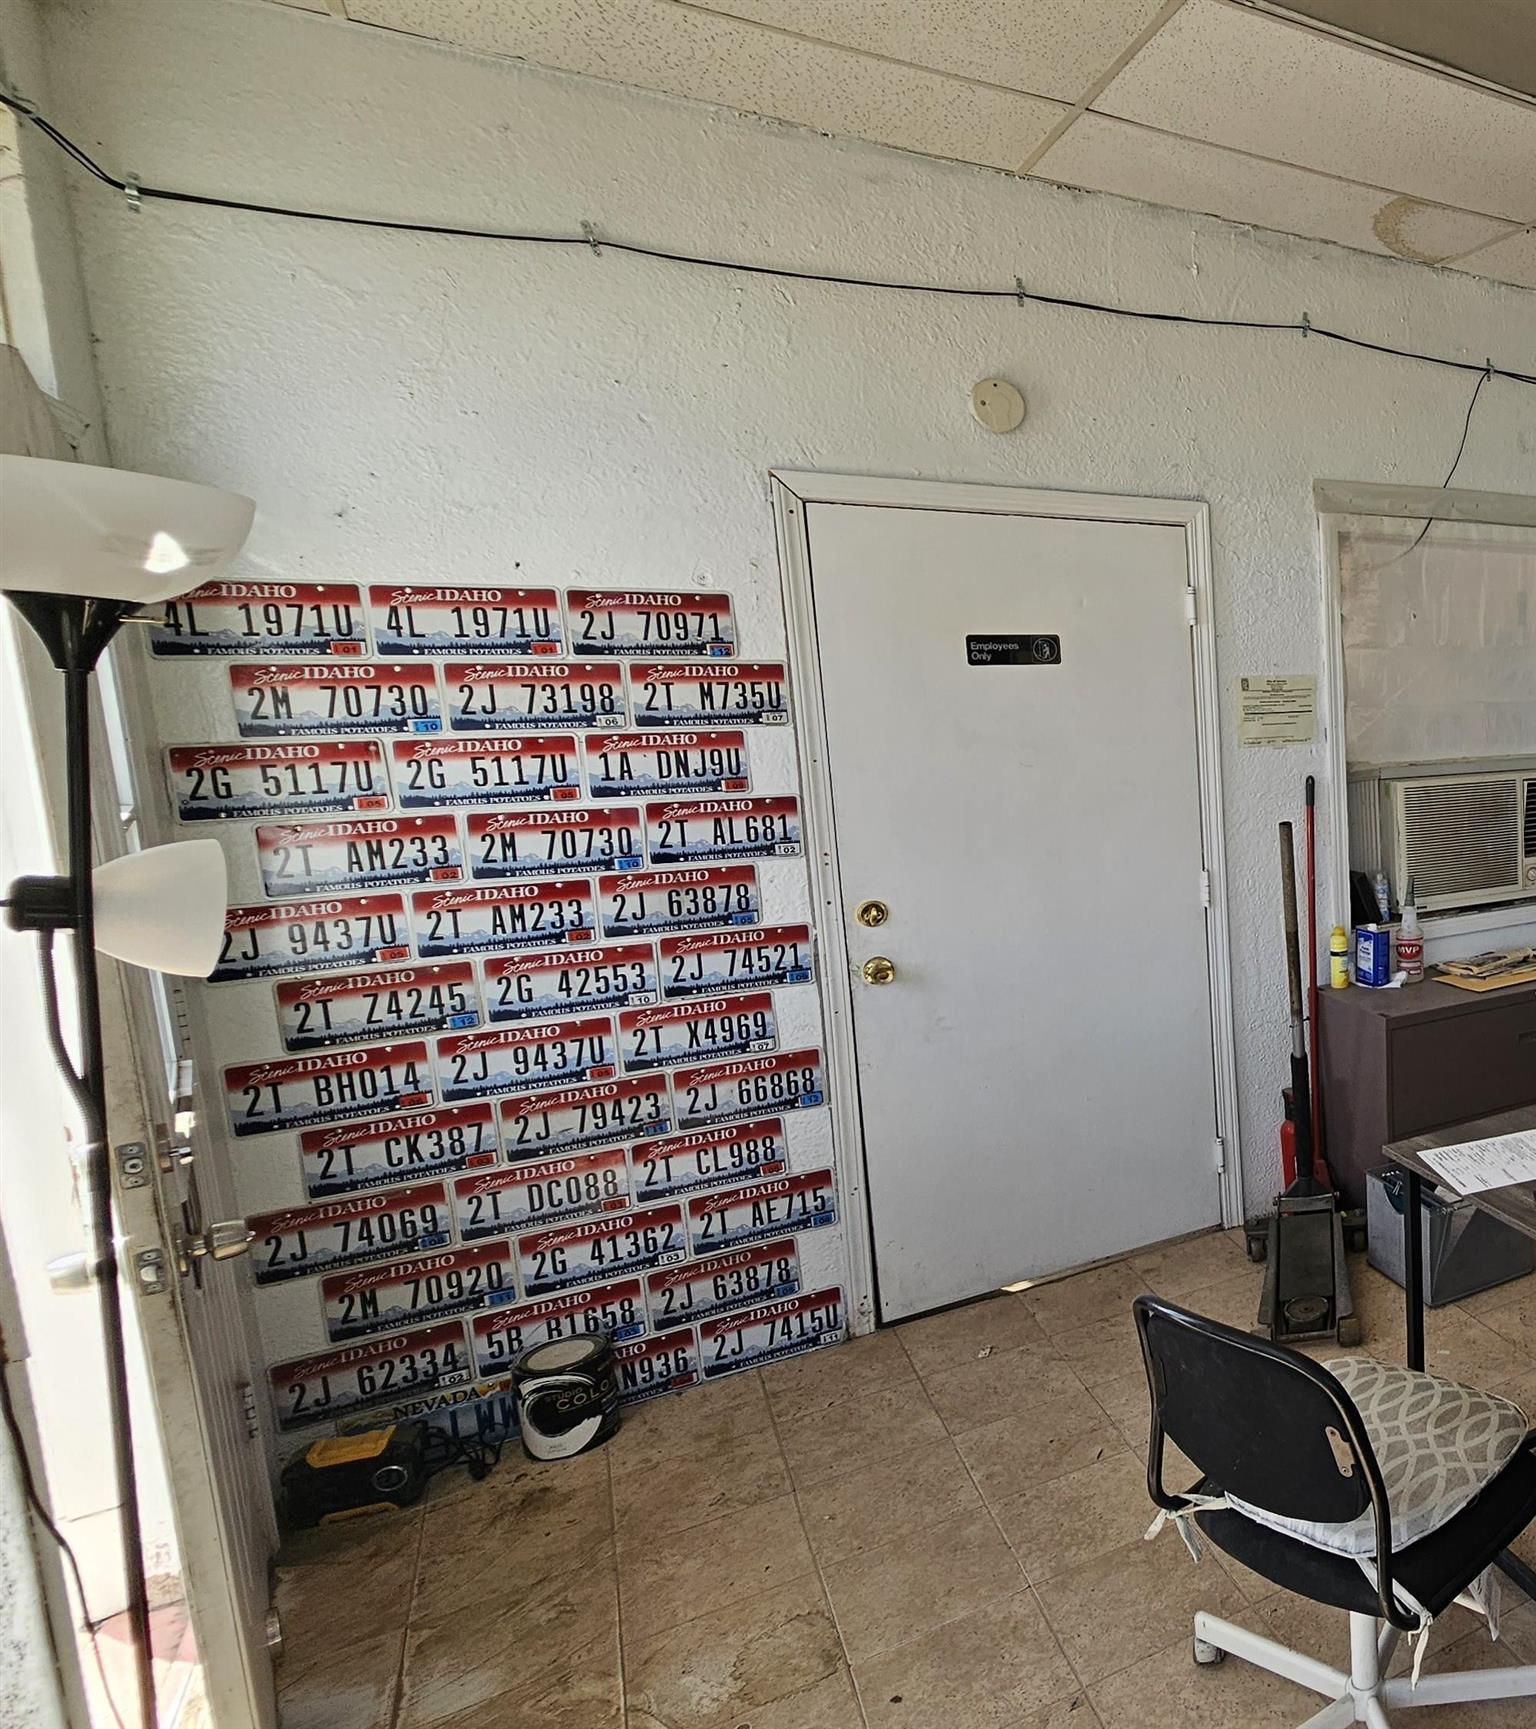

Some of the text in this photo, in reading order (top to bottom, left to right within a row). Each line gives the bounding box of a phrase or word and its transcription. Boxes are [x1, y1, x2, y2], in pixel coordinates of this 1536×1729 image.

[391, 588, 502, 605] Scenic IDAHO
[585, 593, 682, 609] Scenic IDAHO
[164, 603, 353, 639] 4L 1971U
[385, 606, 551, 641] 4L 1971U
[580, 610, 723, 642] 2J 70971
[970, 642, 1019, 651] Employees
[971, 651, 992, 661] Only
[254, 665, 375, 685] Scenic IDAHO
[463, 665, 569, 682] Scenic IDAHO
[646, 665, 739, 681] Scenic IDAHO
[247, 684, 429, 721] 2M 70730
[458, 682, 615, 715] 2J 73198
[643, 682, 782, 712] 2T M735U
[494, 722, 536, 730] FAMOUS
[602, 732, 697, 751] Scenic IDAHO
[194, 744, 320, 767] Scenic IDAHO
[412, 738, 522, 759] Scenic IDAHO
[598, 748, 741, 783] 1A DNJ9U
[185, 761, 374, 804] 2G 5117U
[405, 755, 568, 793] 2G 5117U
[629, 786, 713, 796] FAMOUS POTATOES
[444, 795, 540, 806] FAMOUS POTATOES
[662, 798, 753, 820] Scenic IDAHO
[326, 819, 398, 837] IDAHO
[485, 811, 589, 831] Scenic IDAHO
[657, 813, 791, 850] 2T AL681
[272, 834, 450, 880] 2T AM233
[480, 826, 632, 864] 2M 70730
[514, 865, 605, 877] FAMOUS POTATOES
[616, 869, 709, 892] Scenic IDAHO
[432, 884, 539, 909] Scenic IDAHO
[612, 882, 750, 923] 2J 63878
[426, 898, 584, 942] 2T AM233
[641, 920, 725, 934] FAMOUS POTATOES
[219, 914, 397, 964] 2J 9437U
[462, 938, 556, 954] FAMOUS POTATOES
[676, 929, 765, 954] Scenic IDAHO
[502, 949, 603, 975] Scenic IDAHO
[671, 941, 802, 984] 2J 74521
[300, 969, 416, 1000] Scenic IDAHO
[496, 962, 646, 1007] 2G 42553
[293, 981, 466, 1035] 2T Z4245
[530, 1001, 620, 1018] FAMOUS POTATOES
[636, 998, 727, 1027] Scenic IDAHO
[457, 1023, 560, 1054] Scenic IDAHO
[632, 1009, 767, 1057] 2T X4969
[451, 1035, 605, 1086] 2J 9437U
[690, 1056, 776, 1086] Scenic IDAHO
[241, 1061, 421, 1120] 2T BH014
[519, 1082, 618, 1115] Scenic IDAHO
[686, 1066, 815, 1116] 2J 66868
[513, 1092, 661, 1147] 2J 79423
[316, 1122, 485, 1182] 2T CK387
[643, 1134, 776, 1188] 2T CL988
[466, 1167, 618, 1226] 2T DC088
[699, 1185, 826, 1241] 2T AE715
[264, 1202, 439, 1268] 2J 74069
[536, 1214, 633, 1251] Scenic IDAHO
[531, 1222, 675, 1282] 2G 41362
[337, 1260, 504, 1326] 2M 70920
[660, 1255, 791, 1316] 2J 63878
[713, 1301, 838, 1363] 2J 7415U
[287, 1340, 460, 1414] 2J 62334
[622, 1347, 690, 1390] N936
[393, 1387, 482, 1421] NEVADA
